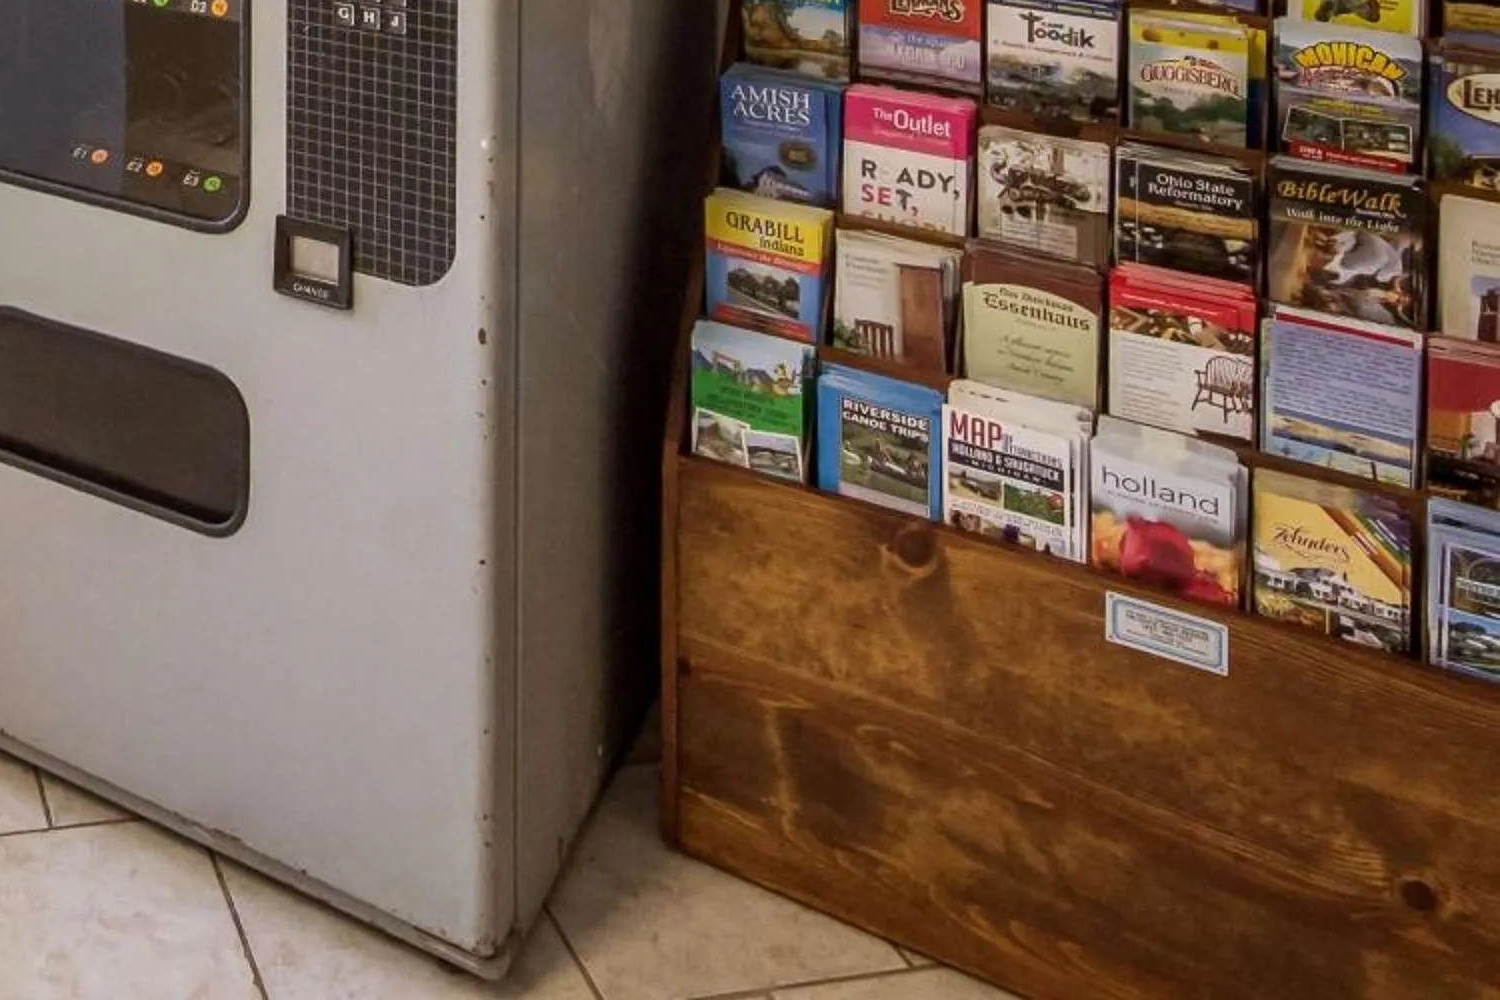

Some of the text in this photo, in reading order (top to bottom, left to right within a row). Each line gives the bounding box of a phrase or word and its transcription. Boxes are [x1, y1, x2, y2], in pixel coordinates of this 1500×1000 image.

[363, 11, 375, 24] H
[391, 15, 399, 27] J
[1018, 11, 1095, 49] Toodik
[1292, 41, 1407, 81] MOHICAN
[731, 84, 810, 110] AMISH
[733, 100, 811, 127] ACRES
[872, 107, 892, 121] The
[893, 109, 951, 138] Outlet
[861, 158, 960, 201] RADY,
[1156, 173, 1235, 197] Ohio State
[861, 184, 919, 216] SET,
[1148, 182, 1244, 211] Reformatory
[725, 211, 805, 244] GRABILL
[759, 236, 804, 257] Indiana
[982, 291, 1090, 331] Essenhaus
[843, 399, 929, 431] RIVERSIDE
[843, 411, 930, 443] CANOE TRIPS
[950, 410, 1003, 450] MAP
[1101, 464, 1219, 517] holland
